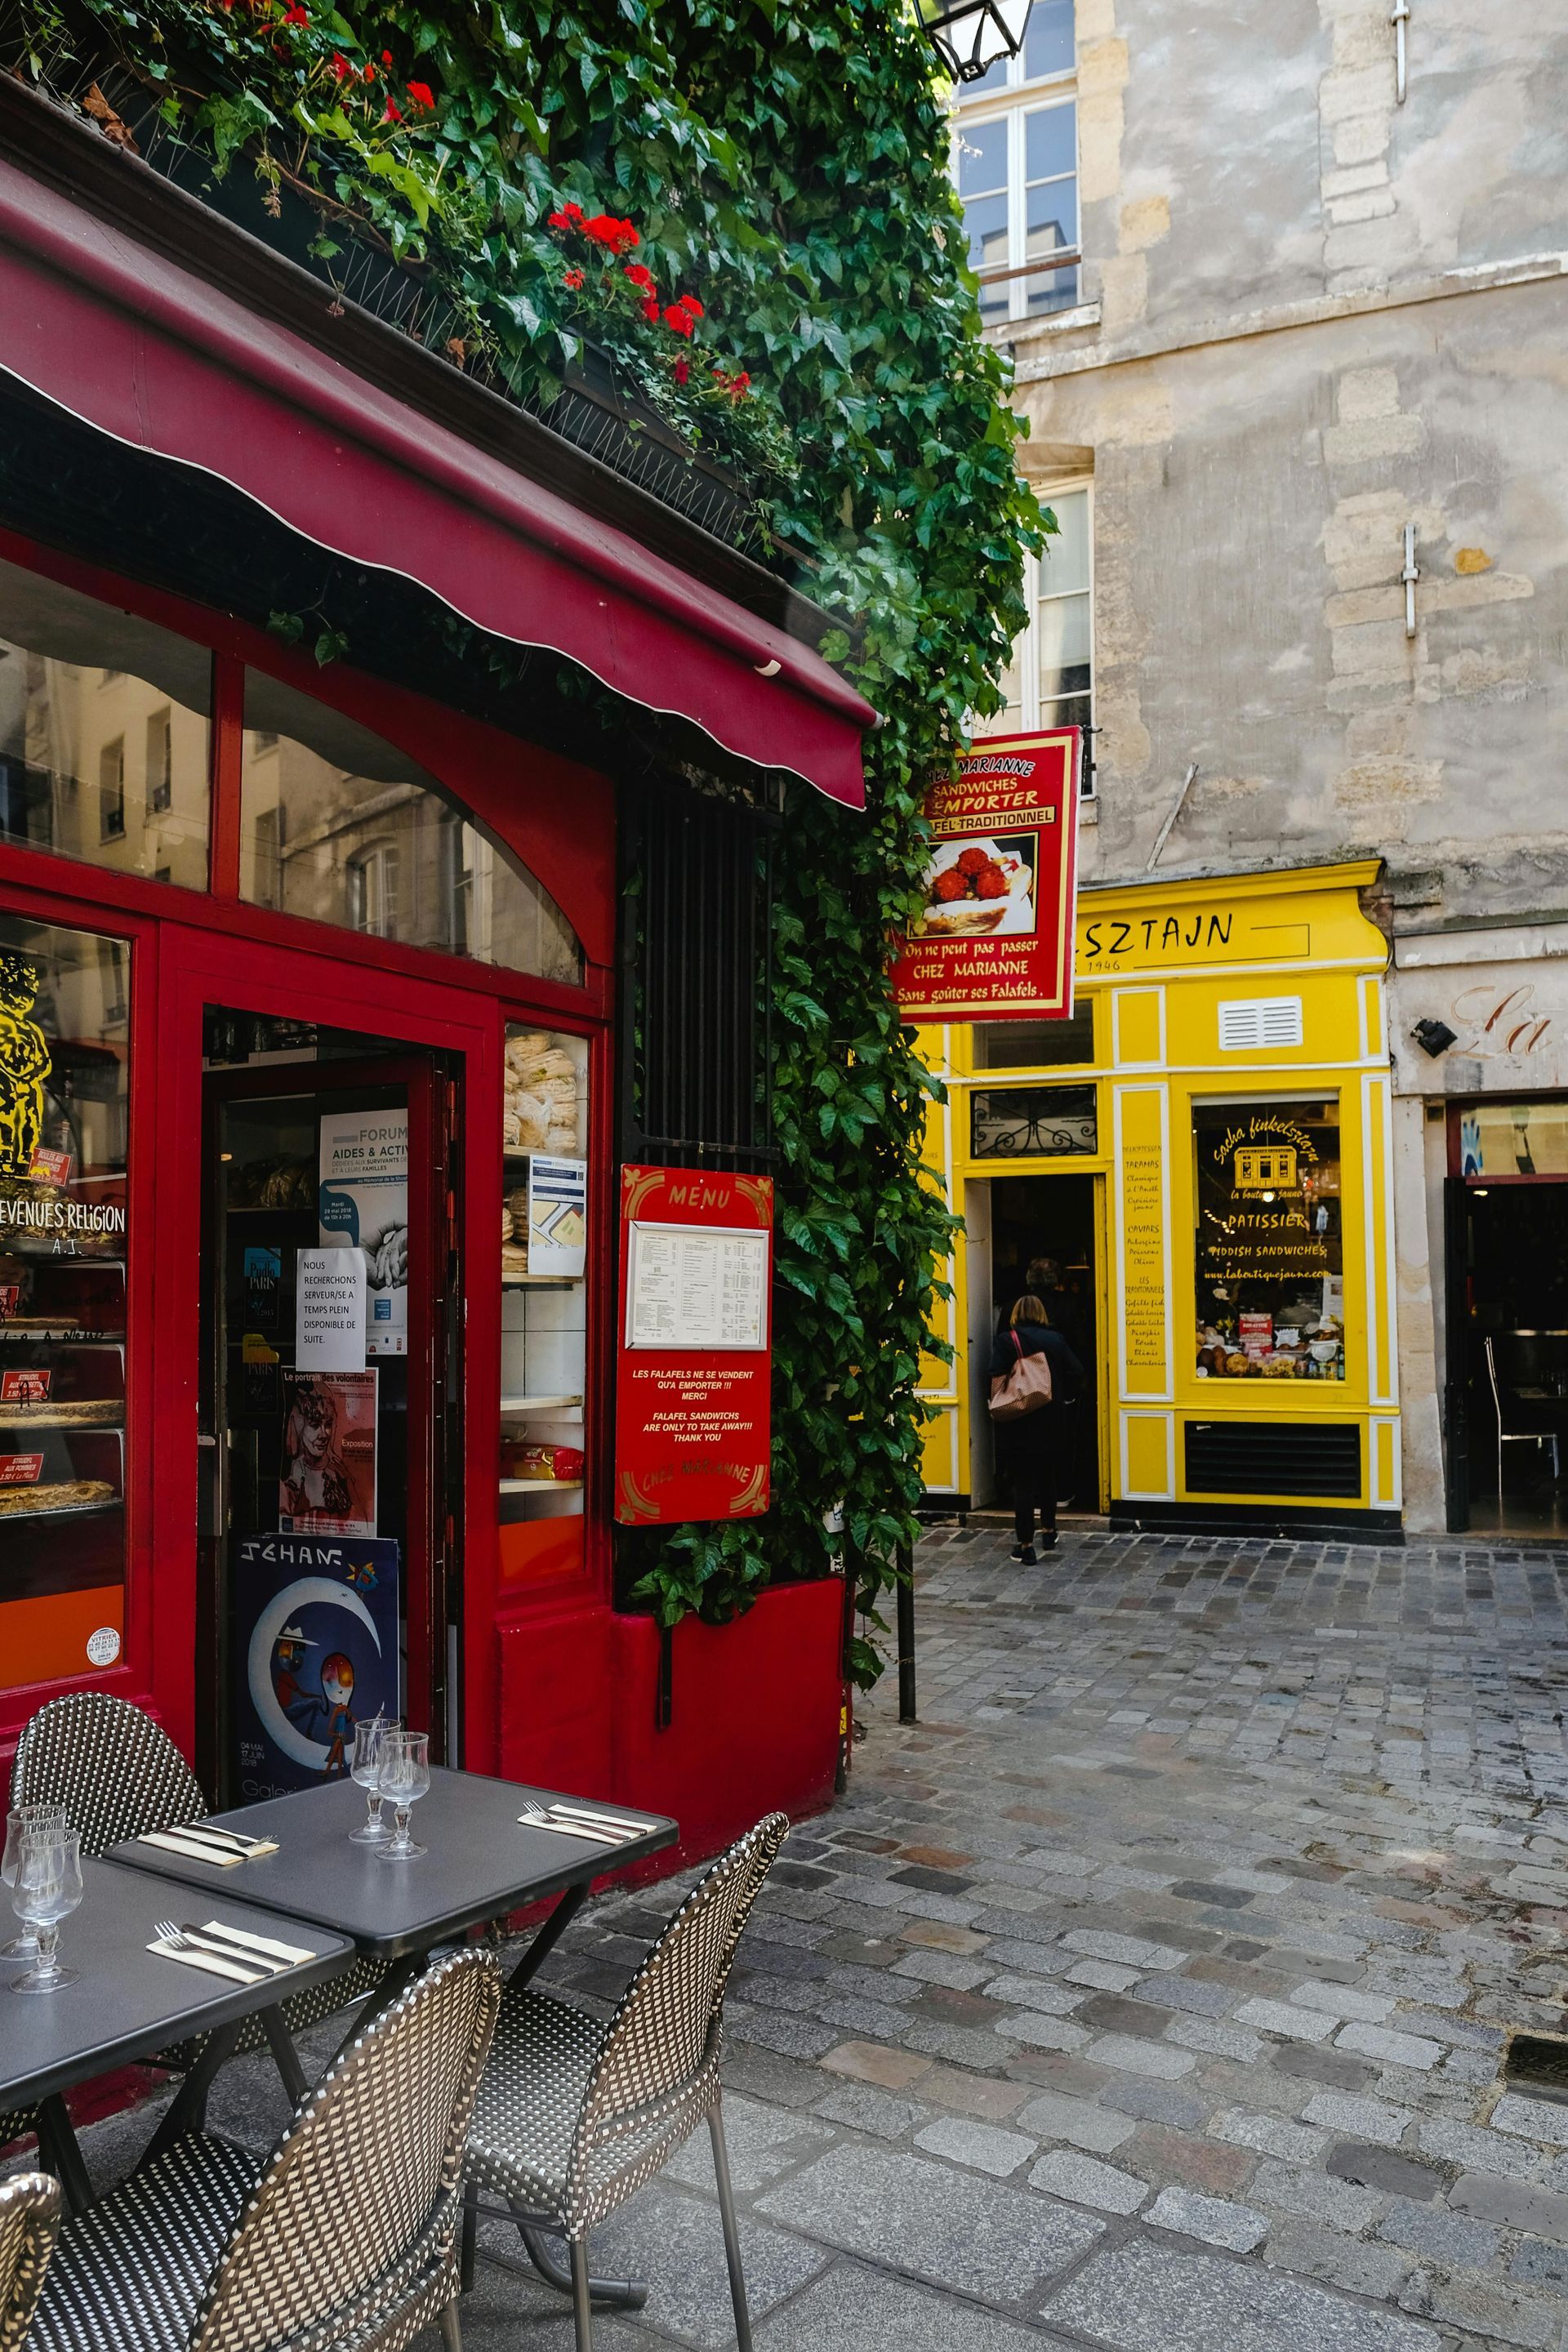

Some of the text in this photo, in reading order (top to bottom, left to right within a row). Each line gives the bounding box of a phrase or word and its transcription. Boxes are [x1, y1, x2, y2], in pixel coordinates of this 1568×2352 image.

[957, 756, 1036, 777] MARIANNE
[933, 777, 1018, 798] SANDWICHES
[934, 791, 1039, 813] EMPORTER
[959, 810, 1052, 829] TRADITIONNEL
[1076, 912, 1232, 958] SZTAJN
[905, 940, 1039, 959] On ne peut pas passer
[913, 960, 1029, 979] CHEZ MARIANNE
[1088, 960, 1120, 973] 1946
[898, 987, 926, 1002] Sans
[931, 986, 969, 1004] goûter
[970, 987, 988, 998] ses
[359, 1127, 408, 1142] FORUM
[332, 1148, 364, 1160] AIDES
[368, 1147, 375, 1157] &
[1126, 1160, 1160, 1169] TARAMAS
[669, 1185, 730, 1209] MENU
[1228, 1213, 1307, 1229] PATISSIER
[1128, 1224, 1160, 1233] CAVIARS
[1256, 1245, 1326, 1258] SANDWICHES
[304, 1261, 325, 1270] NOUS
[249, 1276, 275, 1290] PARIS
[304, 1276, 356, 1285] RECHERCHONS
[1139, 1276, 1150, 1285] LES
[304, 1290, 346, 1300] SERVEUR/SE
[304, 1306, 350, 1314] TEMPS PLEIN
[304, 1321, 356, 1329] DISPONIBLE DE
[304, 1335, 325, 1343] SUITE.
[283, 1372, 374, 1383] Le portrait des volontaires
[633, 1370, 754, 1379] LES FALAFELS NE SE VENDENT
[657, 1380, 676, 1390] QU'A
[679, 1381, 722, 1390] EMPORTER
[681, 1392, 707, 1401] MERCI
[653, 1411, 739, 1421] FALAFEL SANDWICHS
[643, 1422, 753, 1432] ARE ONLY TO TAKE AWAY!!!
[674, 1433, 721, 1442] THANK YOU
[341, 1439, 373, 1449] Exposition
[91, 1633, 117, 1642] VITRIER
